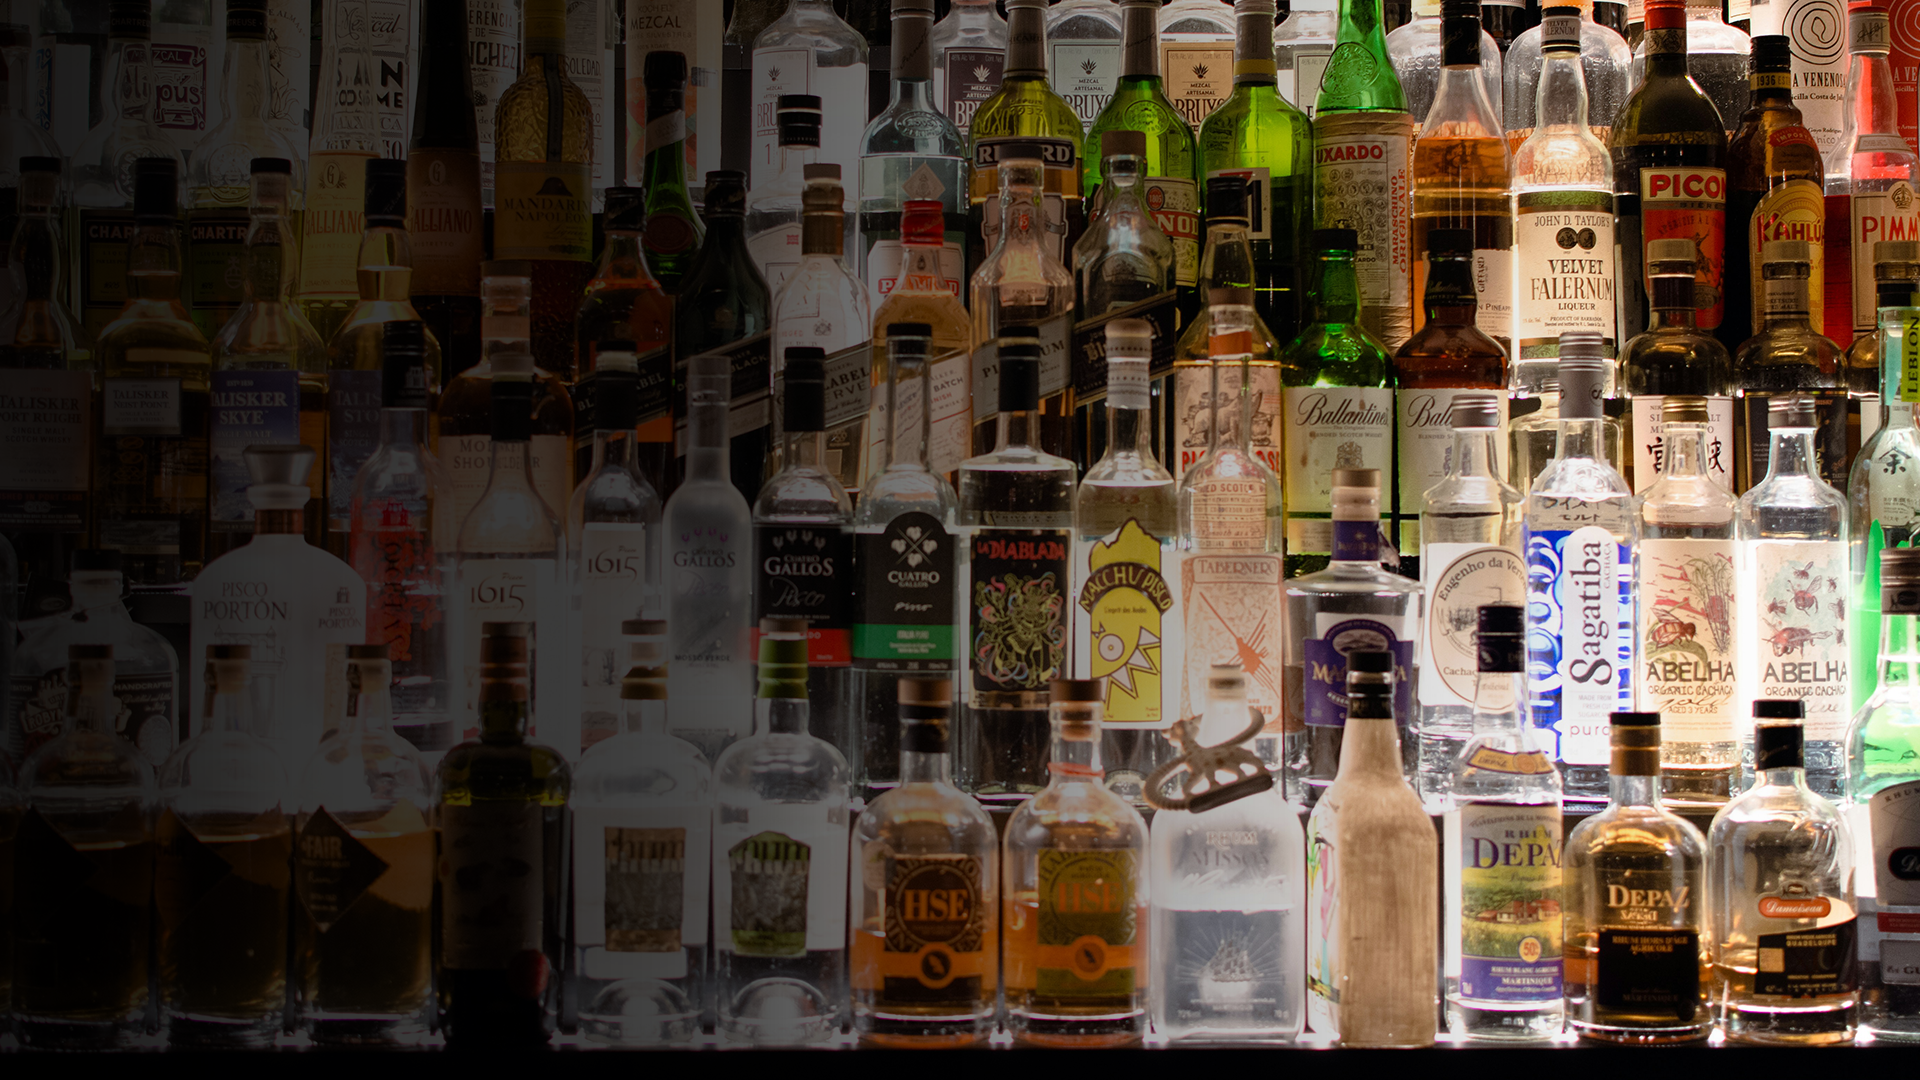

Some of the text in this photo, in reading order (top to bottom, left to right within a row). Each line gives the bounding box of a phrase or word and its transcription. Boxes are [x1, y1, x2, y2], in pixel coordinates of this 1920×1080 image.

[630, 15, 682, 31] MEZCAL
[1756, 76, 1776, 87] 1936
[1391, 176, 1399, 265] MARASCHINO
[1399, 169, 1408, 273] ORIGINALE
[1534, 215, 1561, 228] JOHN
[1563, 215, 1572, 226] D.
[1547, 259, 1604, 275] VELVET
[1531, 277, 1612, 301] FALERNUM
[1558, 302, 1596, 311] LIQUEUR
[1907, 316, 1920, 393] LEBLON
[113, 389, 169, 399] TALISKER
[34, 412, 83, 425] RUIGHE
[219, 410, 265, 425] SKYE
[5, 435, 72, 444] SCOTCH WHISKY
[12, 427, 67, 436] SINGLE MALT
[674, 551, 735, 568] GALLOS
[764, 557, 834, 576] GALLOS
[887, 570, 940, 582] CUATRO
[1439, 556, 1503, 602] Engenho da
[222, 582, 268, 598] PISCO
[1080, 565, 1172, 611] MACCHU PISCO
[203, 599, 288, 621] PORTÓN
[1569, 541, 1613, 686] Sagatiba
[1647, 661, 1736, 683] ABELHA
[1763, 661, 1848, 683] ABELHA
[1648, 686, 1693, 696] ORGANIC
[904, 889, 969, 922] HSE
[1058, 882, 1121, 914] HSE
[1608, 884, 1691, 913] DEPAZ
[1501, 976, 1554, 986] MARTINIQUE
